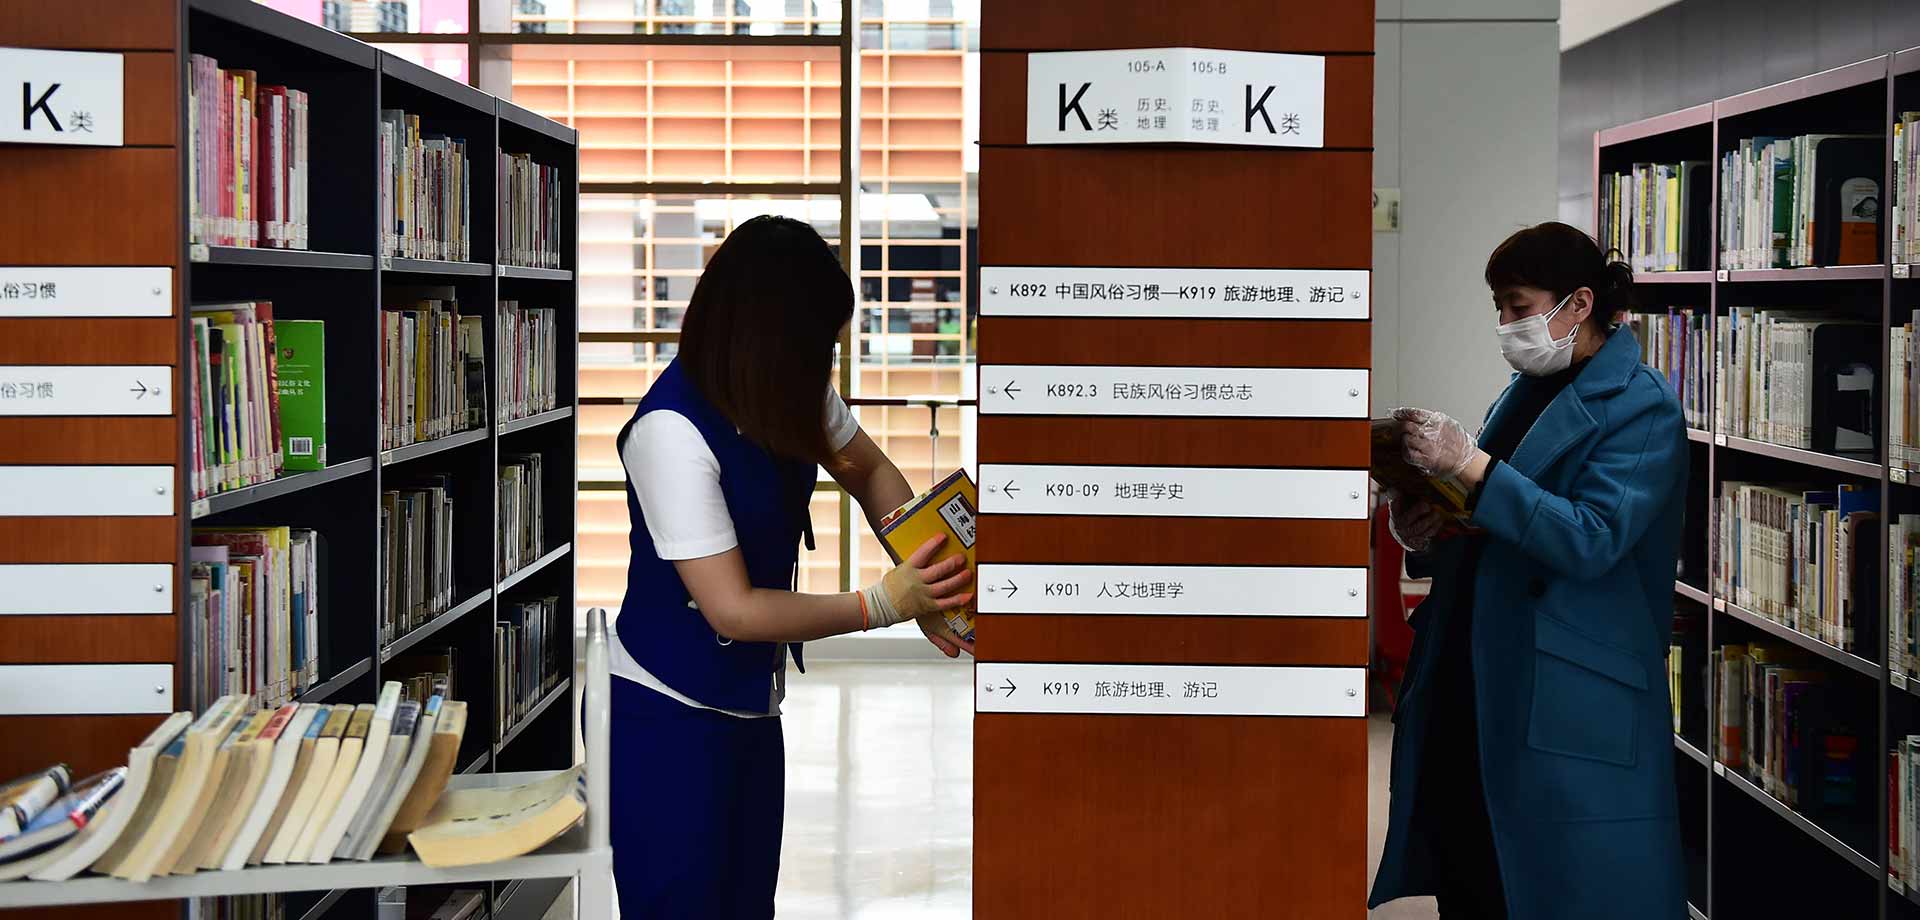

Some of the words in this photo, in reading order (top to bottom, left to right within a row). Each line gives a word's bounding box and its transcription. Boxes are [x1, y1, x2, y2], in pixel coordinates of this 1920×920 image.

[1127, 60, 1166, 73] 105-A
[1191, 61, 1228, 75] 105-B
[1136, 115, 1168, 130] 地理
[1190, 117, 1222, 132] 地理
[0, 281, 57, 300] 俗习惯
[1009, 281, 1047, 298] K892
[1223, 284, 1345, 304] 旅游地理、游记
[1, 381, 54, 399] 俗习惯
[1046, 383, 1098, 399] K892.3
[1112, 382, 1254, 401] 民族风俗习惯总志
[1045, 481, 1100, 498] K90-09
[1113, 481, 1185, 500] 地理学史
[1044, 582, 1081, 598] K901
[1095, 581, 1185, 600] 人文地理学
[1042, 680, 1080, 697] K919
[1093, 680, 1219, 700] 旅游地理、游记
